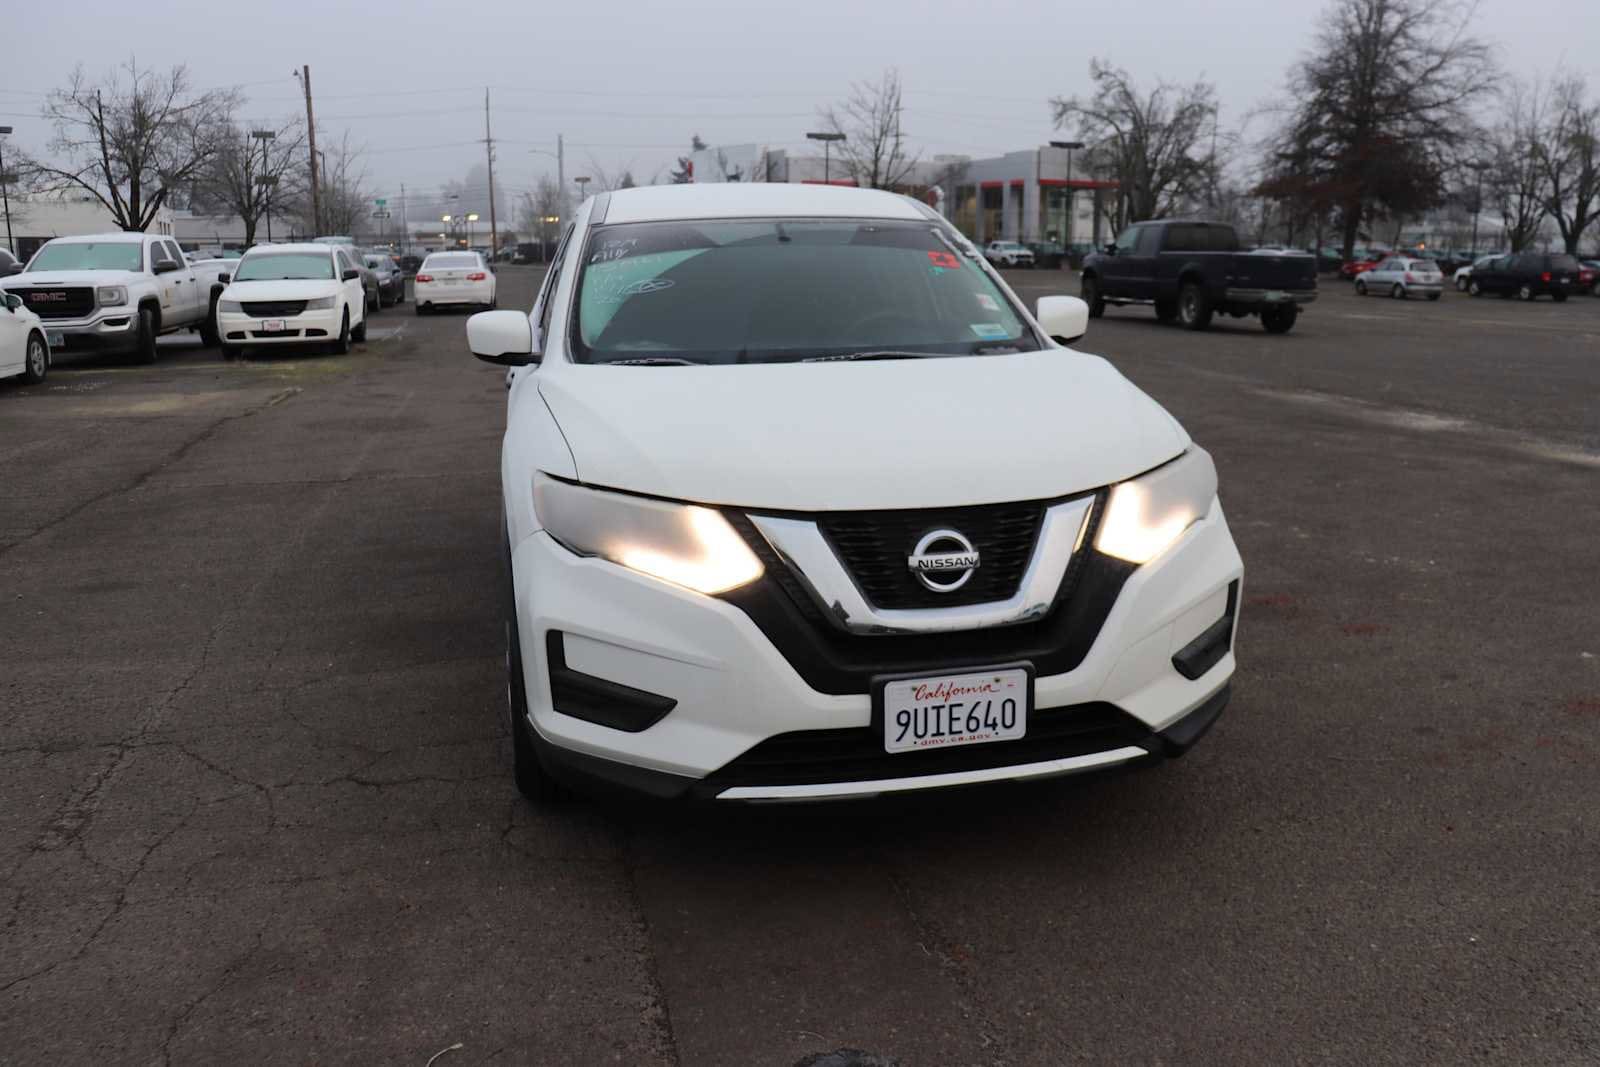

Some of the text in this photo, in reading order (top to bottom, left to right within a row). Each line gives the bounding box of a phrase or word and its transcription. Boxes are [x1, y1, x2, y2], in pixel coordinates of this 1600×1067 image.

[31, 292, 67, 301] GMC
[918, 556, 975, 569] NISSAN
[914, 681, 1000, 702] California
[895, 698, 1017, 743] 9UIE640
[920, 733, 992, 747] dmv.ca.gov
